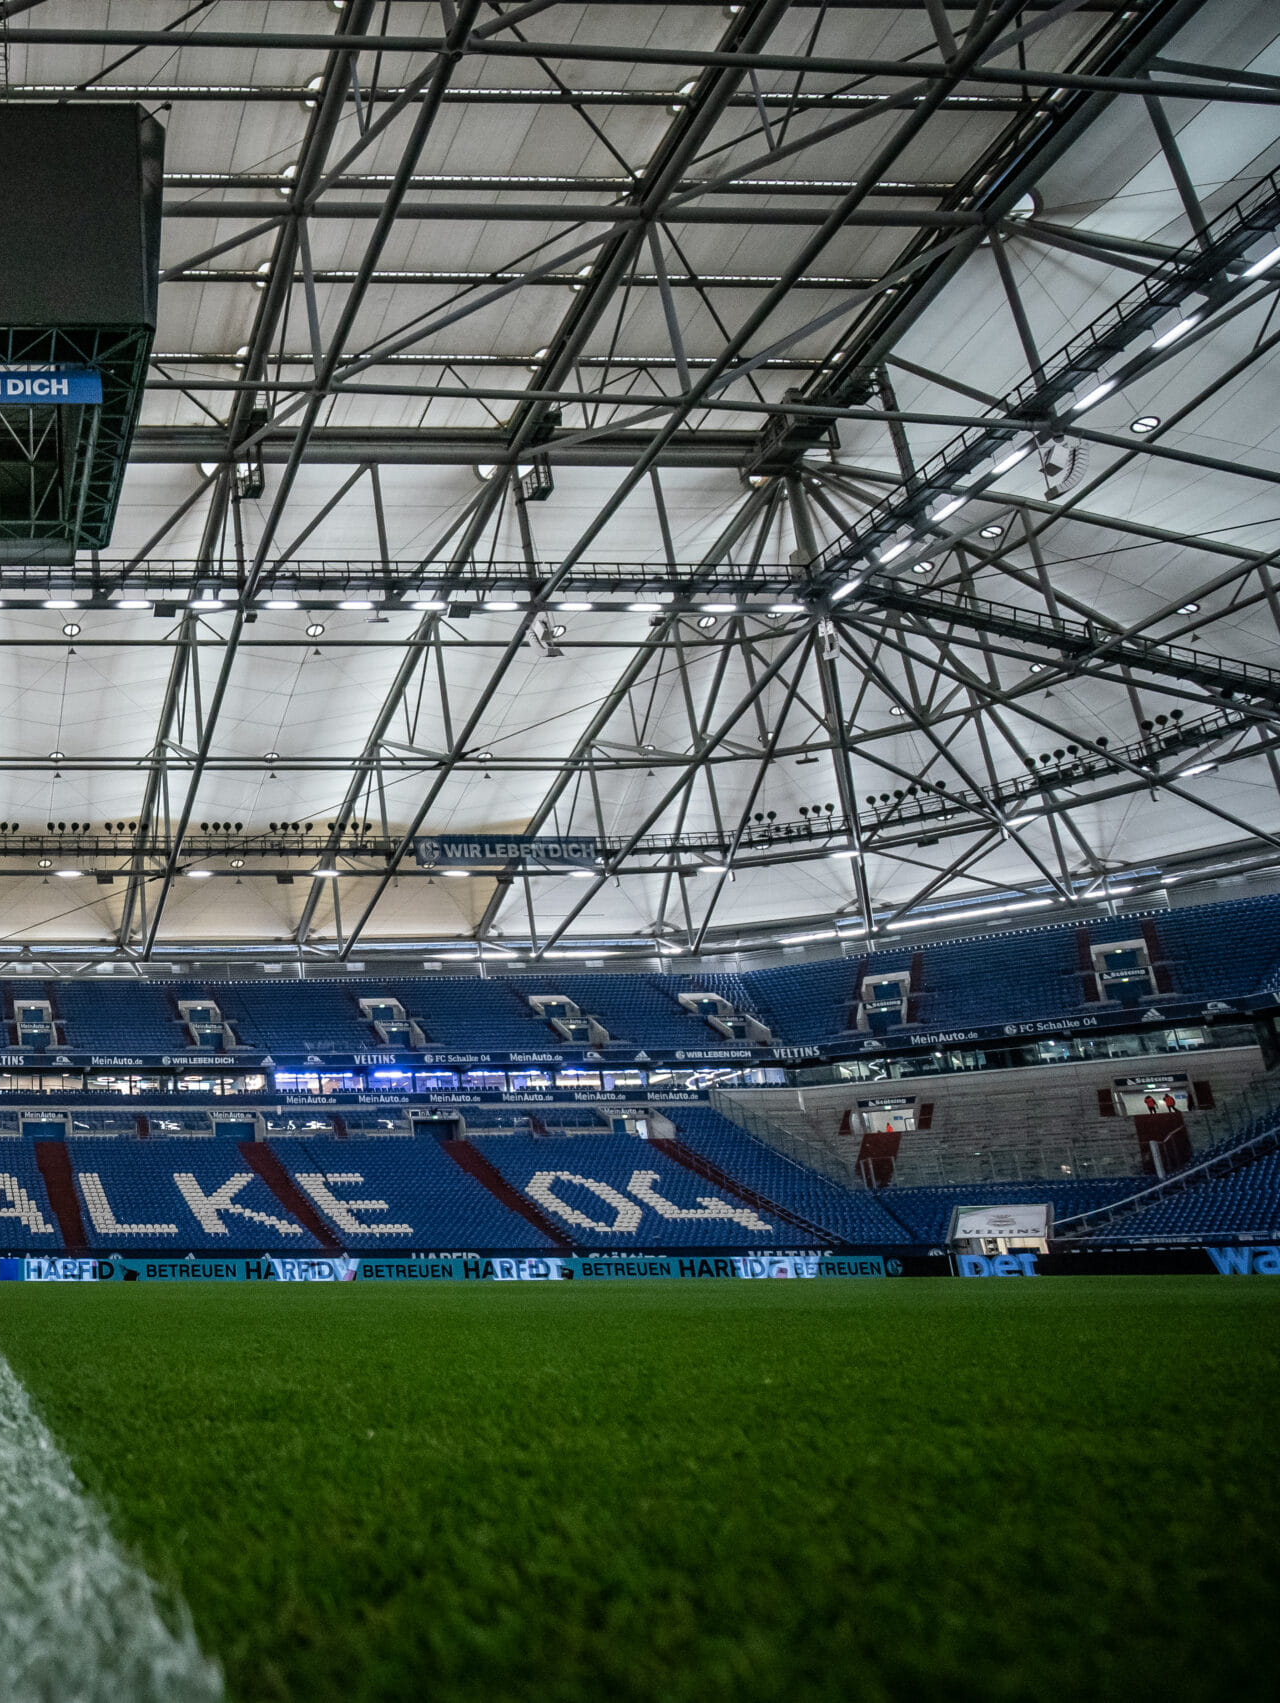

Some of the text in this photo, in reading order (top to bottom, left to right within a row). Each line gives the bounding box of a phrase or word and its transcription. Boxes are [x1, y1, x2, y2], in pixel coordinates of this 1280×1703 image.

[6, 379, 69, 396] DICH
[443, 843, 596, 858] WIR LEBEN DICH
[1020, 1016, 1098, 1033] FC Schalke 04
[911, 1031, 978, 1045] MeinAuto.de
[510, 1052, 563, 1062] MeinAuto.de
[686, 1050, 703, 1058] WIR
[730, 1050, 752, 1058] DICH
[773, 1046, 820, 1059] VELTINS
[91, 1056, 143, 1066] MeinAuto.de
[172, 1056, 235, 1065] WIR LEBEN DICH
[354, 1054, 396, 1065] VELTINS
[435, 1053, 491, 1063] FC Schalke 04
[286, 1094, 337, 1104] MeinAuto.de
[358, 1094, 410, 1103] MeinAuto.de
[430, 1093, 481, 1102] MeinAuto.de
[502, 1093, 554, 1102] MeinAuto.de
[575, 1092, 626, 1101] MeinAuto.de
[647, 1091, 699, 1100] MeinAuto.de
[24, 1111, 64, 1119] MeinAuto.de
[213, 1111, 253, 1119] MeinAuto.de
[962, 1227, 1041, 1235] VELTINS
[146, 1264, 237, 1278] BETREUEN
[363, 1264, 453, 1278] BETREUEN
[582, 1262, 671, 1276] BETREUEN
[794, 1261, 882, 1276] BETREUEN
